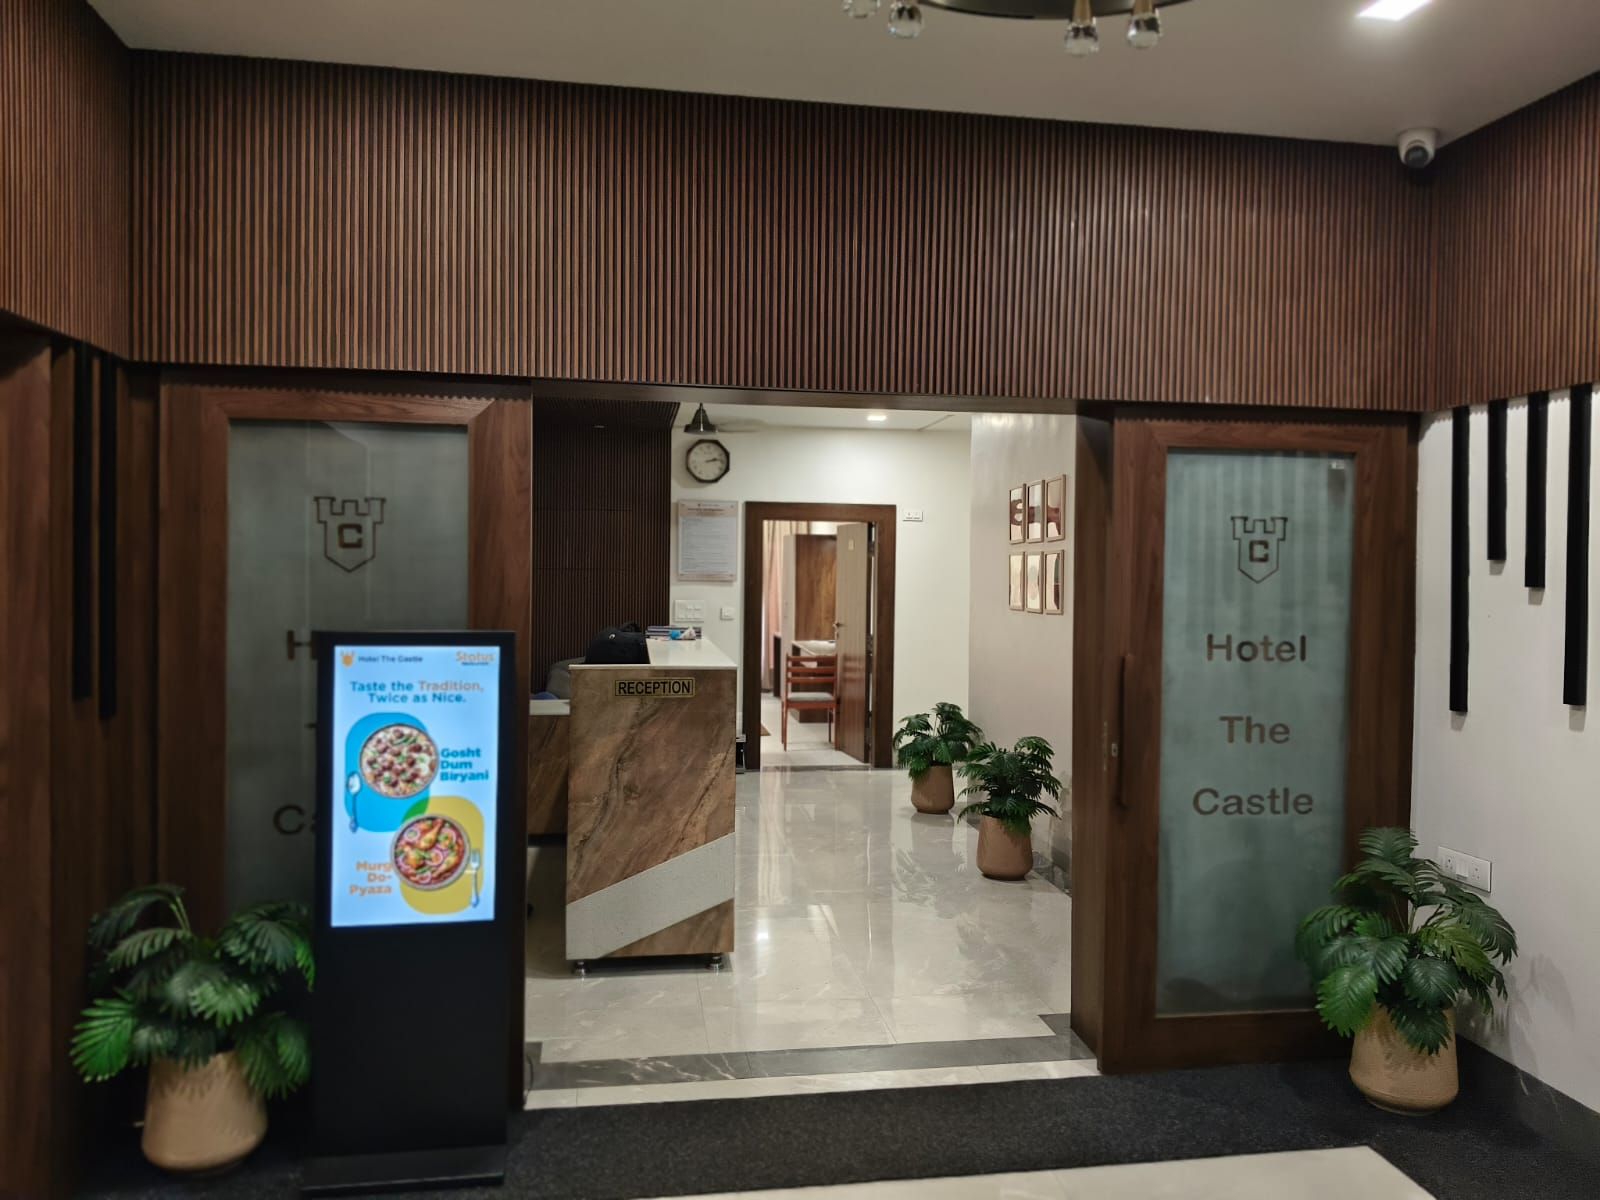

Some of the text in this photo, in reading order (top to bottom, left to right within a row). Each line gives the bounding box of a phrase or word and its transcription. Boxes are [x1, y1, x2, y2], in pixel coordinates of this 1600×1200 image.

[1206, 633, 1307, 663] Hotel
[382, 655, 396, 663] The
[398, 655, 424, 663] Castle
[350, 681, 485, 693] Taste the Tradition,
[618, 681, 691, 695] RECEPTION
[368, 693, 467, 703] Twice as Nice.
[1219, 715, 1290, 744] The
[440, 747, 482, 758] Gosht
[440, 760, 473, 769] Dum
[440, 770, 489, 783] Biryani
[1192, 787, 1314, 816] Castle
[355, 860, 392, 873] Murg
[349, 884, 393, 897] Pyaza
